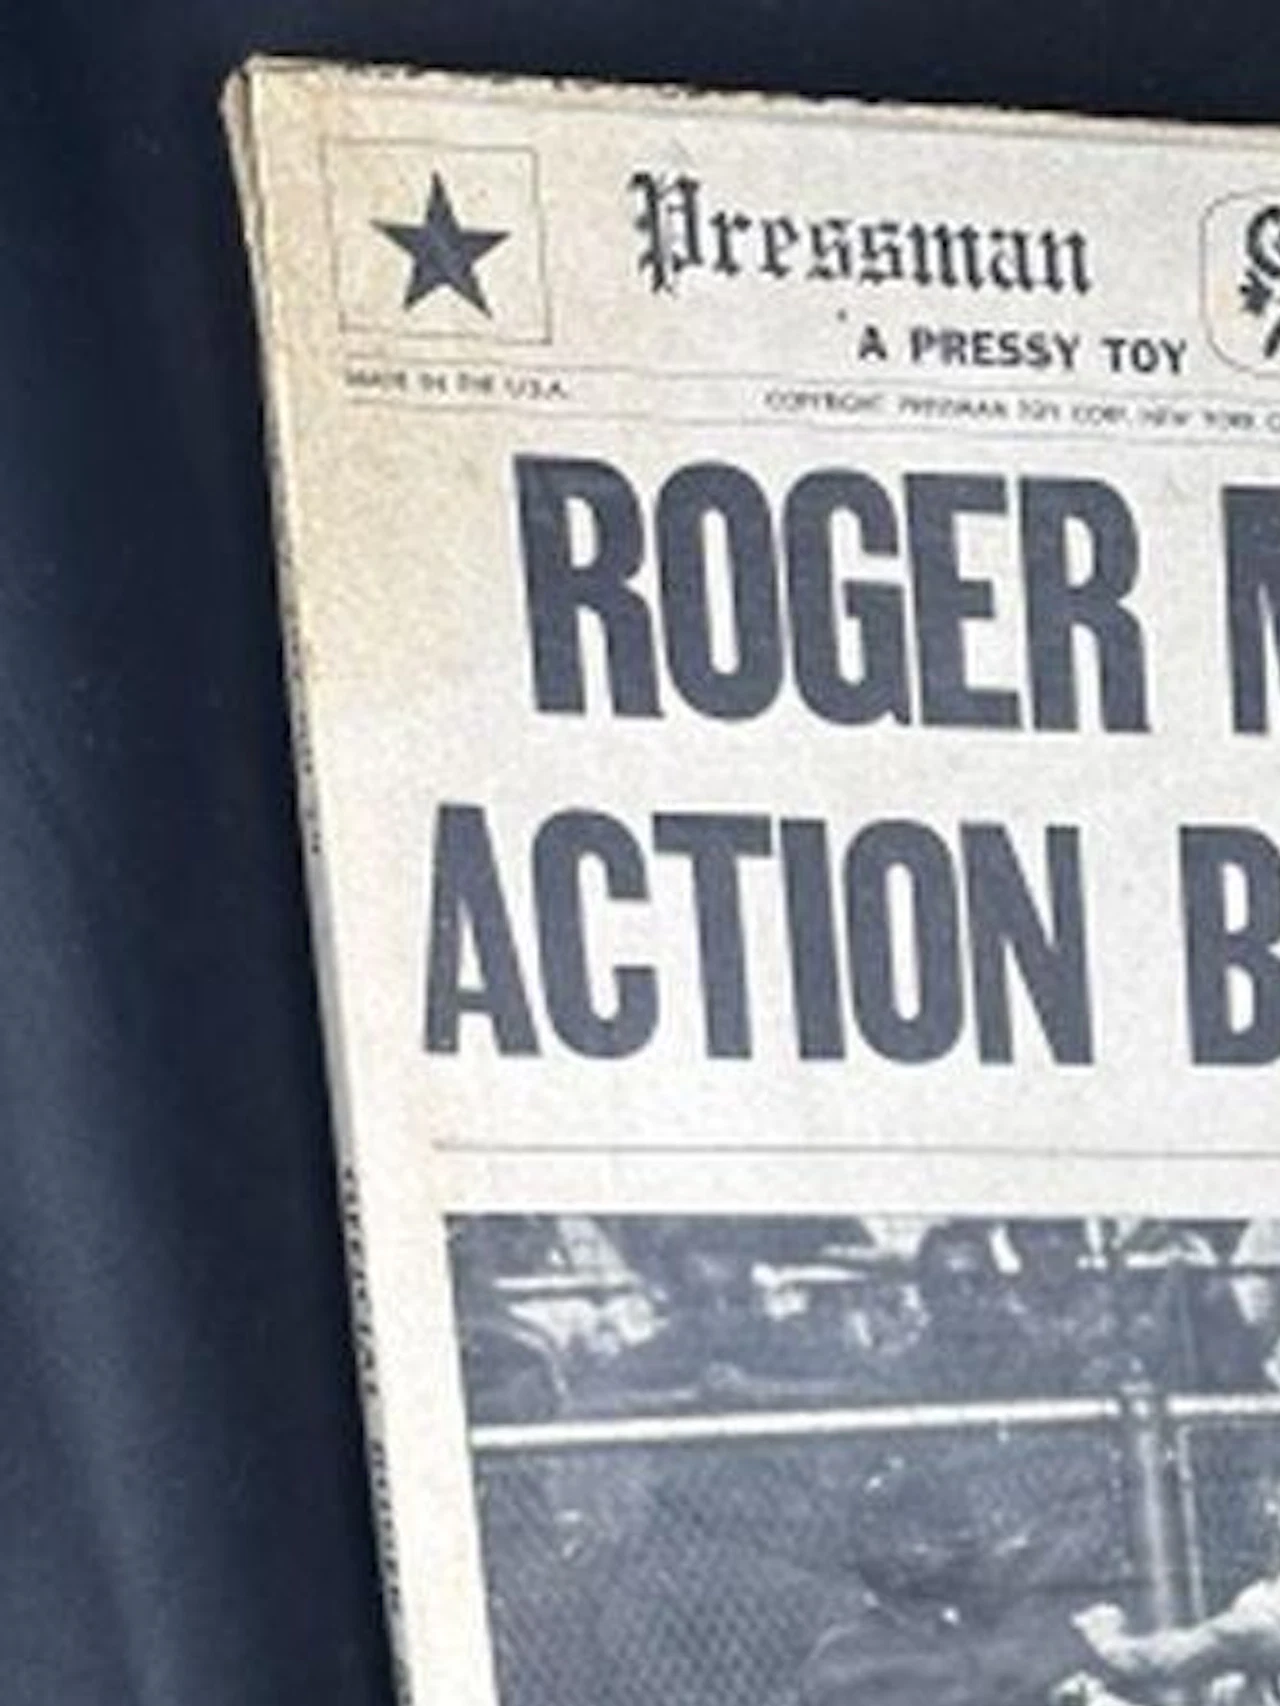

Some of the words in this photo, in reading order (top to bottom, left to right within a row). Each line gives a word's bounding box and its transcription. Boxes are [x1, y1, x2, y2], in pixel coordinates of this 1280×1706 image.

[629, 171, 1092, 298] Pressman
[858, 329, 888, 362] A
[911, 329, 1081, 373] PRESSY
[1102, 337, 1188, 376] TOY
[513, 453, 1151, 736] ROGER
[423, 802, 1096, 1067] ACTION
